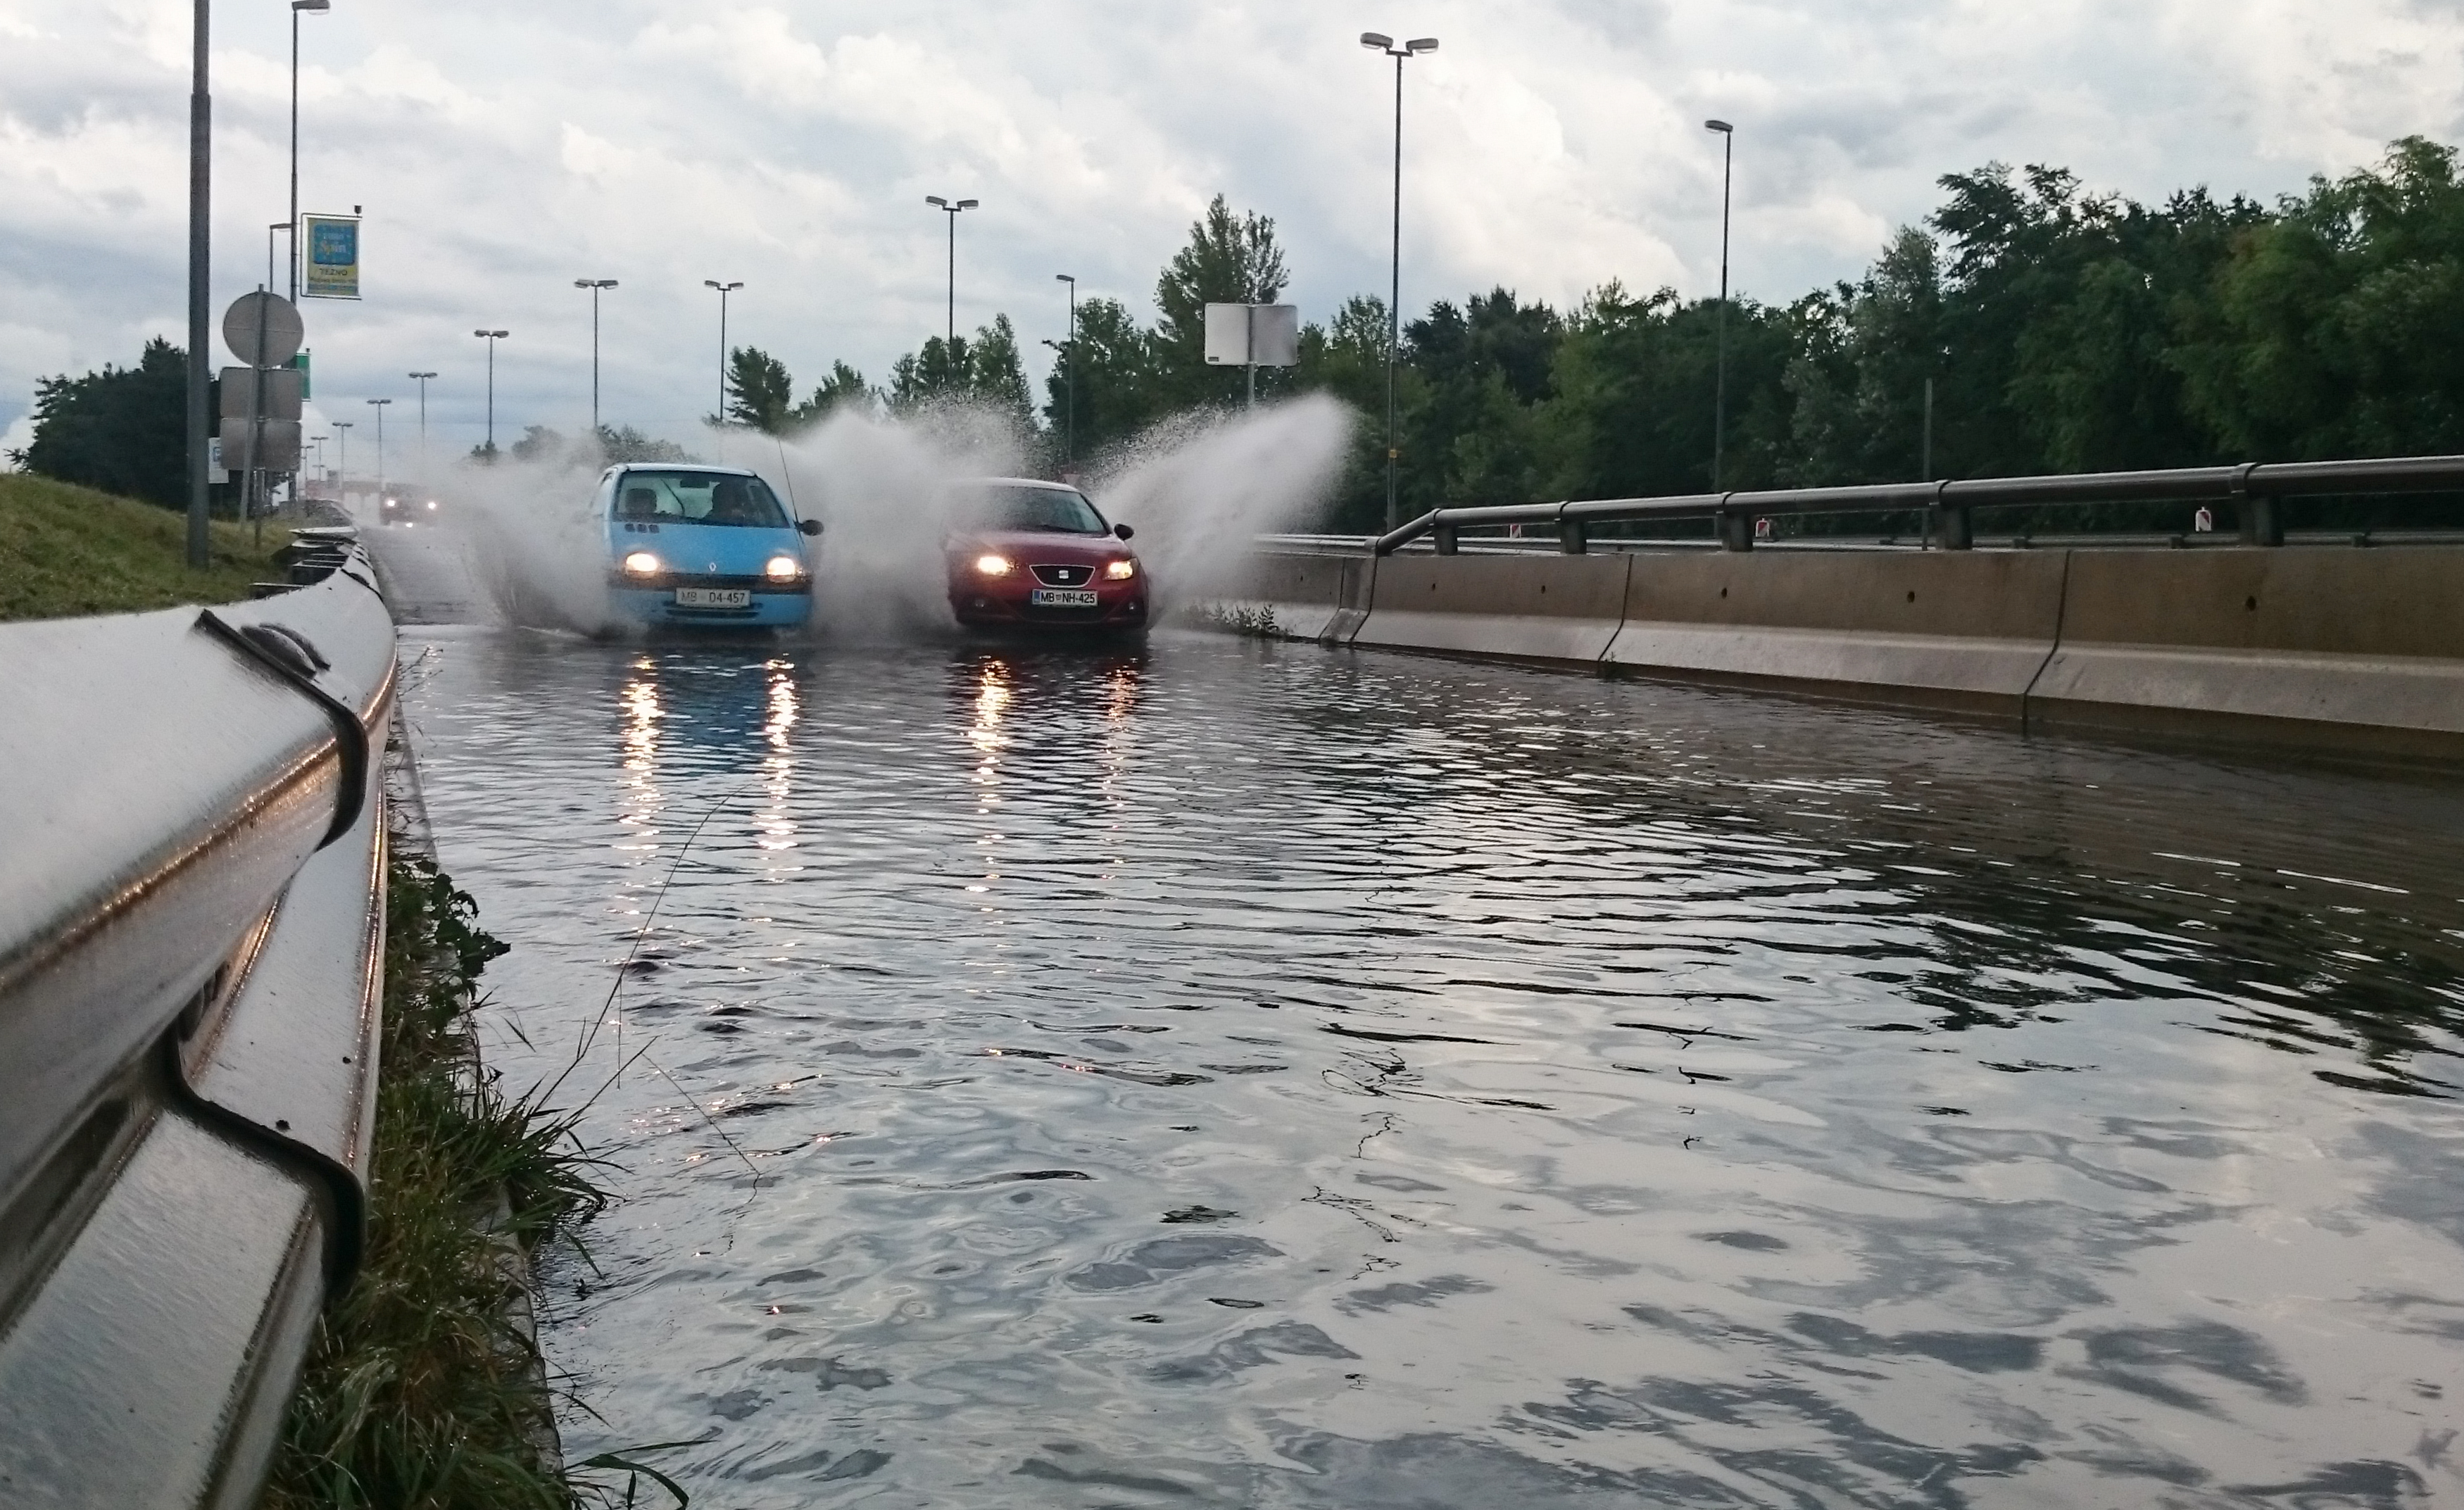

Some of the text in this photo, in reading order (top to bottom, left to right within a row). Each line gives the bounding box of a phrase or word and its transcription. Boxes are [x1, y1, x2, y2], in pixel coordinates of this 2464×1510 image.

[681, 591, 697, 602] MB
[1041, 592, 1095, 603] MB NH-425
